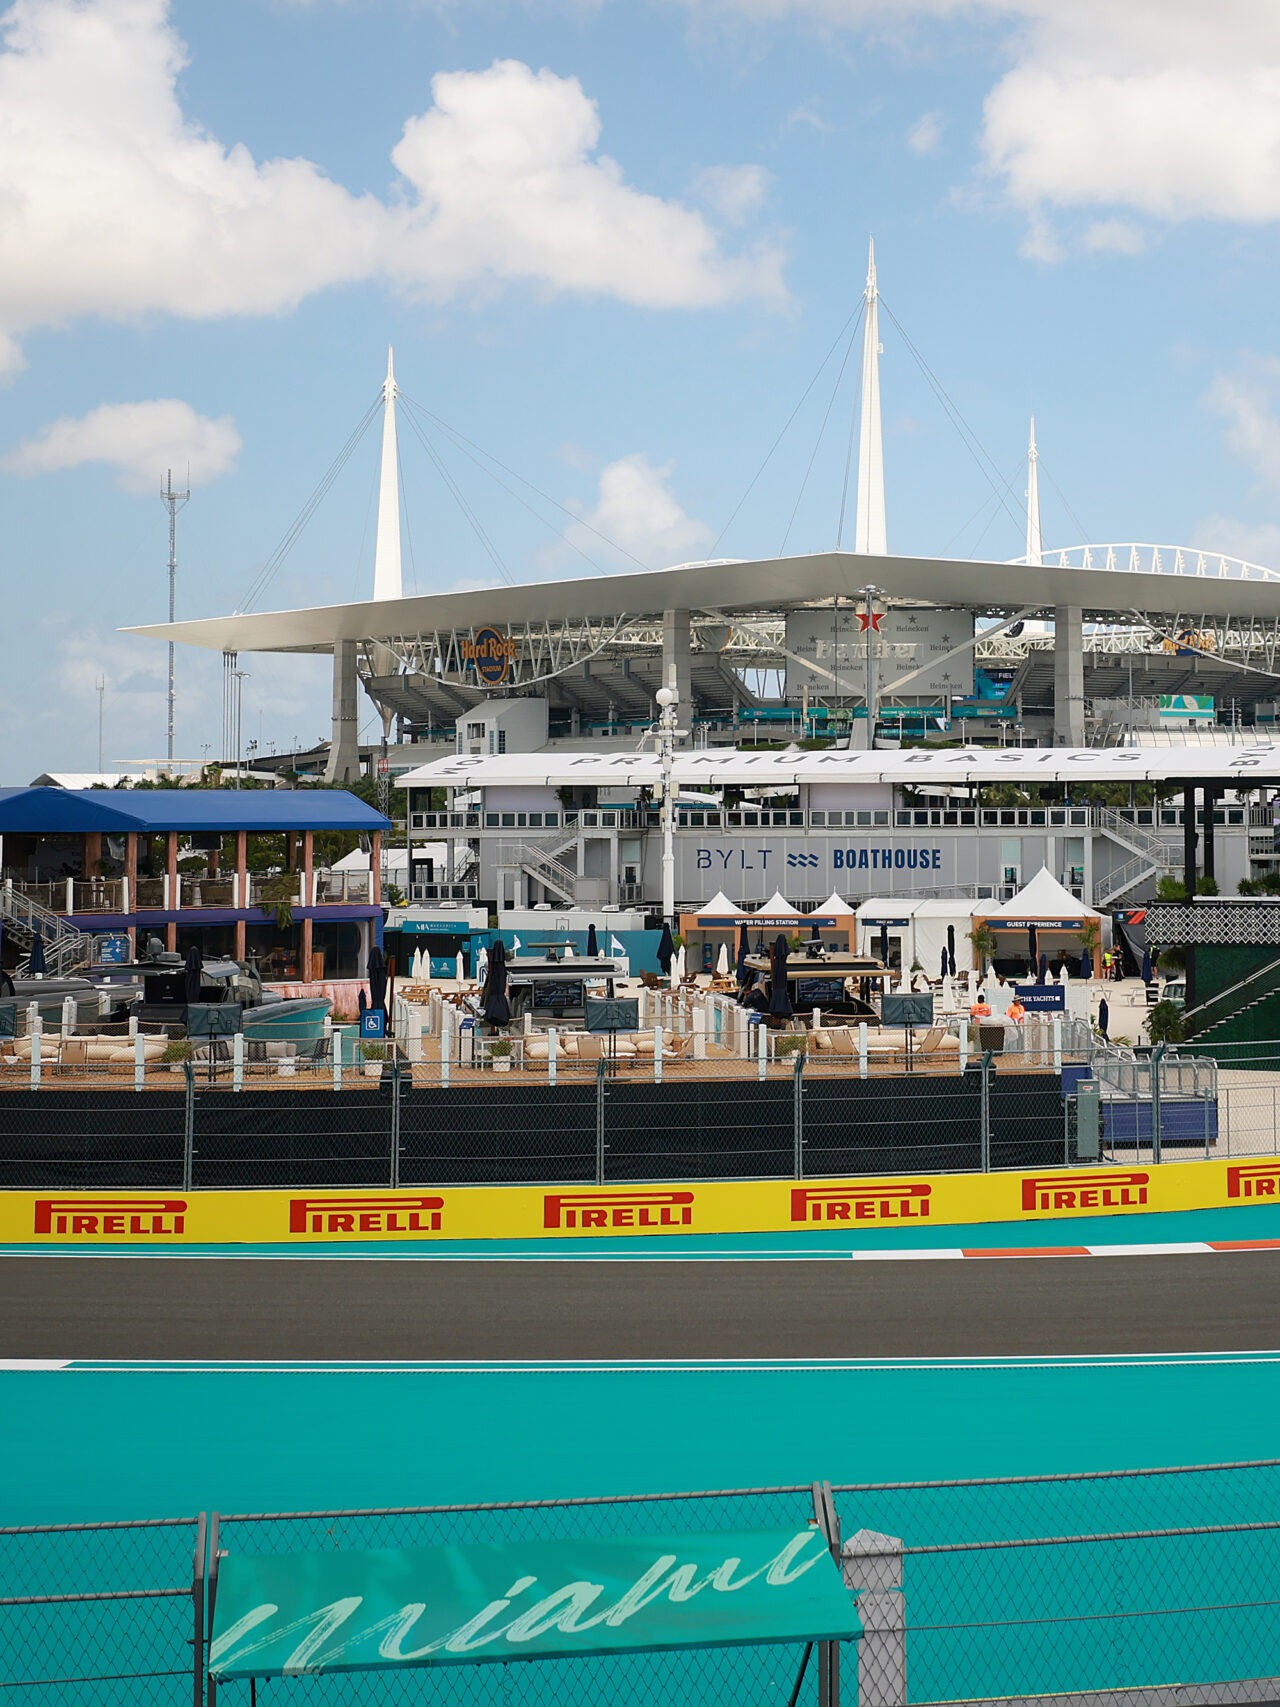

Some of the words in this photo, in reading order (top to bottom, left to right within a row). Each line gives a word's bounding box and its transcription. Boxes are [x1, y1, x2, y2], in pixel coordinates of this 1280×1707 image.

[460, 638, 488, 659] Hard
[488, 637, 518, 661] Rock
[482, 665, 502, 673] STADIUM
[903, 753, 1142, 763] BASICS
[696, 849, 772, 869] BYLT
[833, 849, 941, 869] BOATHOUSE
[791, 1184, 932, 1221] PIRELLI
[1022, 1173, 1149, 1210] PIRELLI
[34, 1200, 188, 1234] PIRELLI
[290, 1197, 444, 1233] PIRELLI
[544, 1191, 694, 1228] PIRELLI
